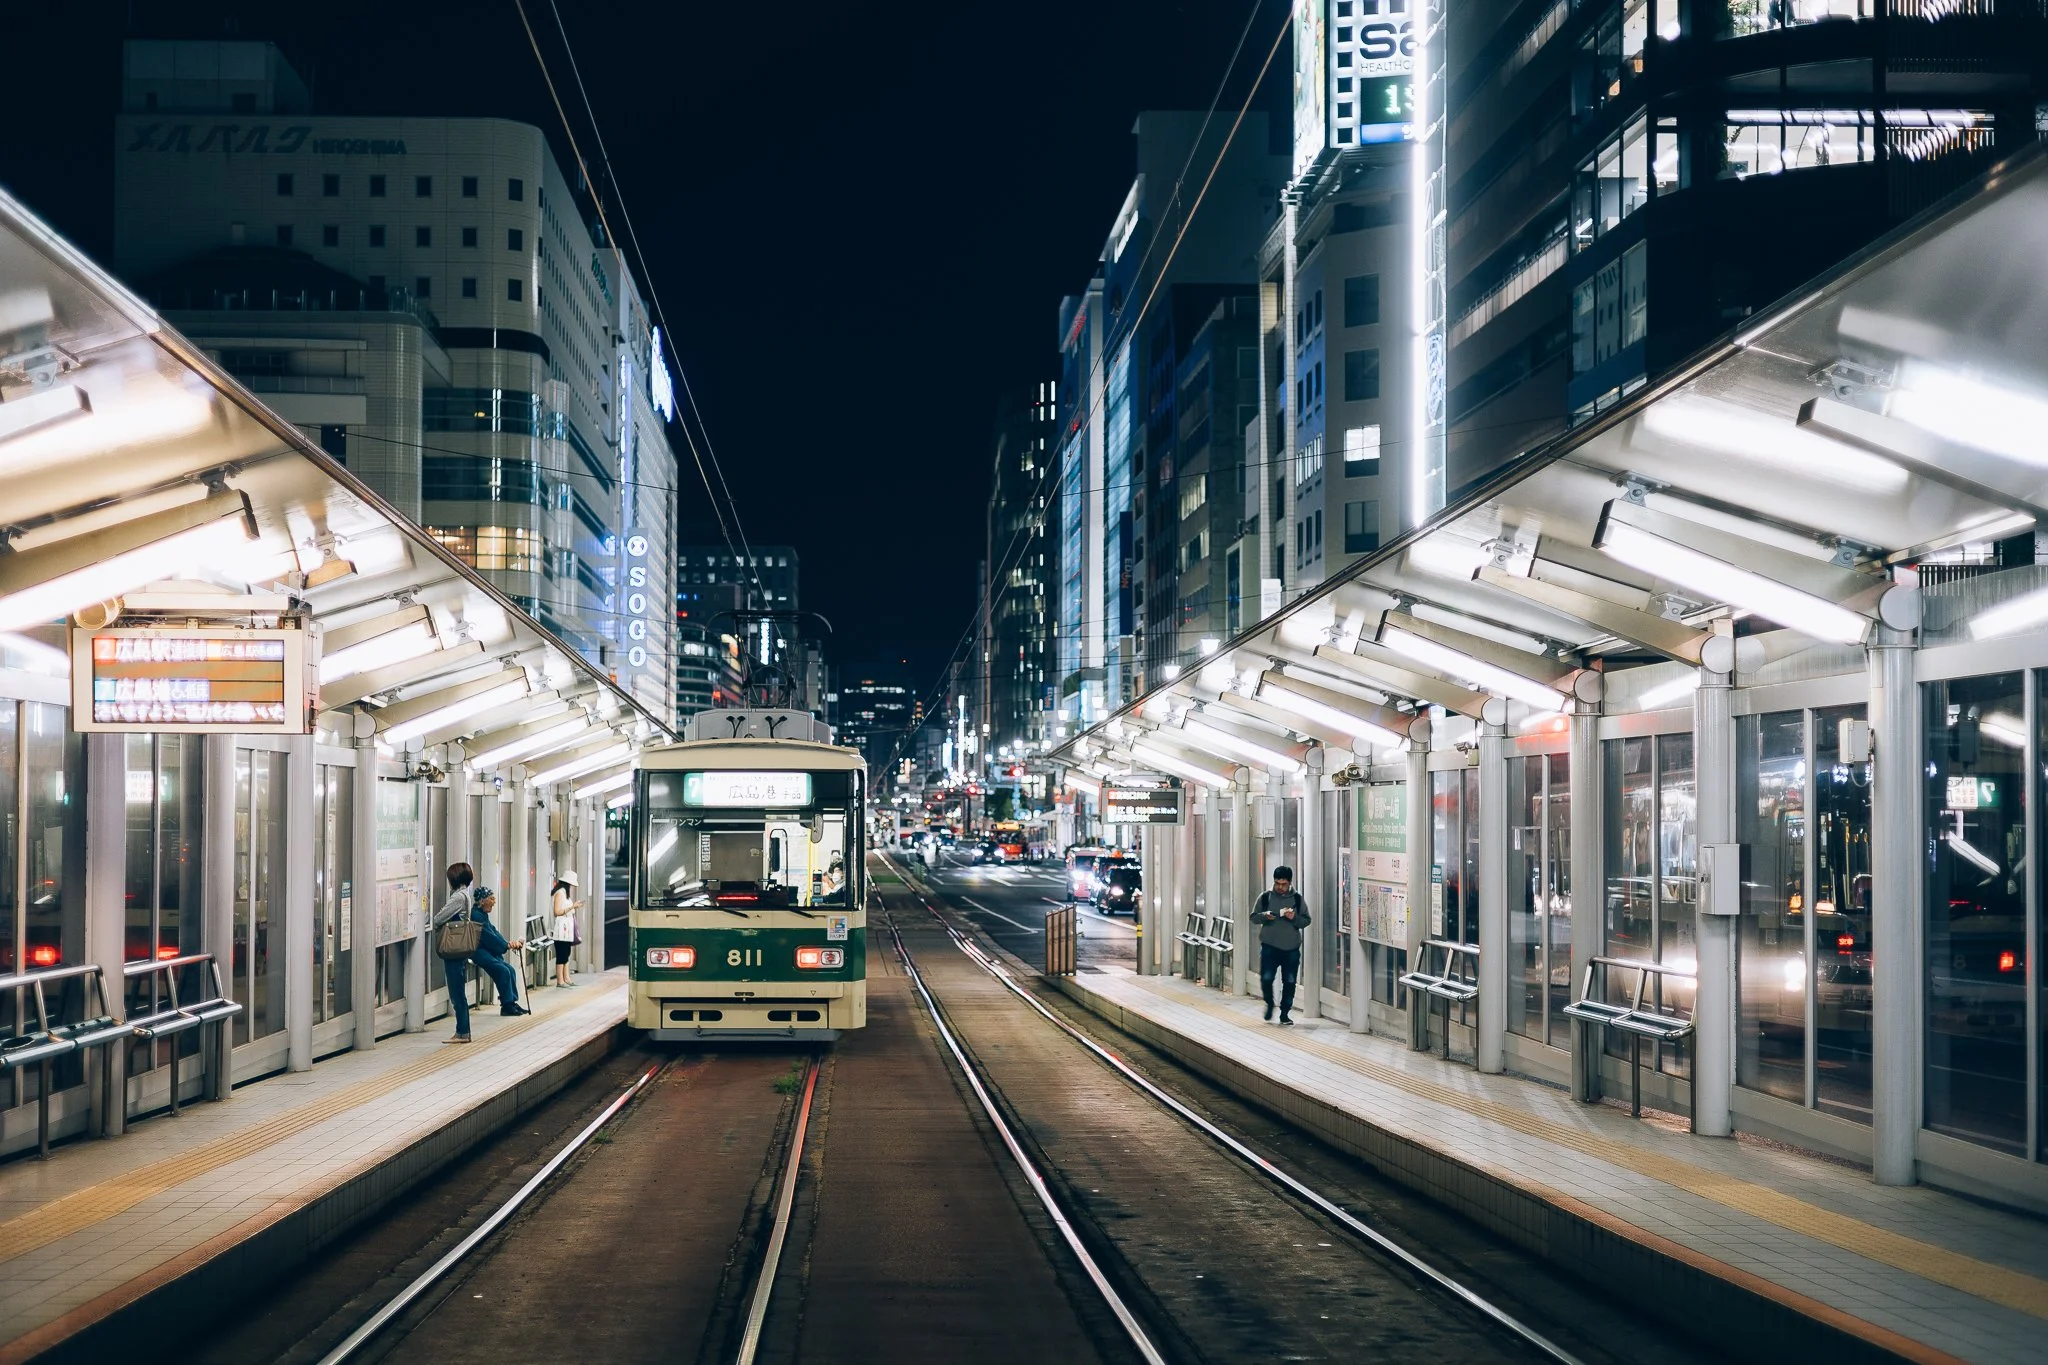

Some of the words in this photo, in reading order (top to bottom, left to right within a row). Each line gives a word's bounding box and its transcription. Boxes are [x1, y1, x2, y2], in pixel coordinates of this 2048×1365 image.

[628, 566, 647, 667] SOGO
[689, 778, 701, 798] 7
[670, 818, 702, 827] ワンマン
[727, 949, 762, 967] 811
